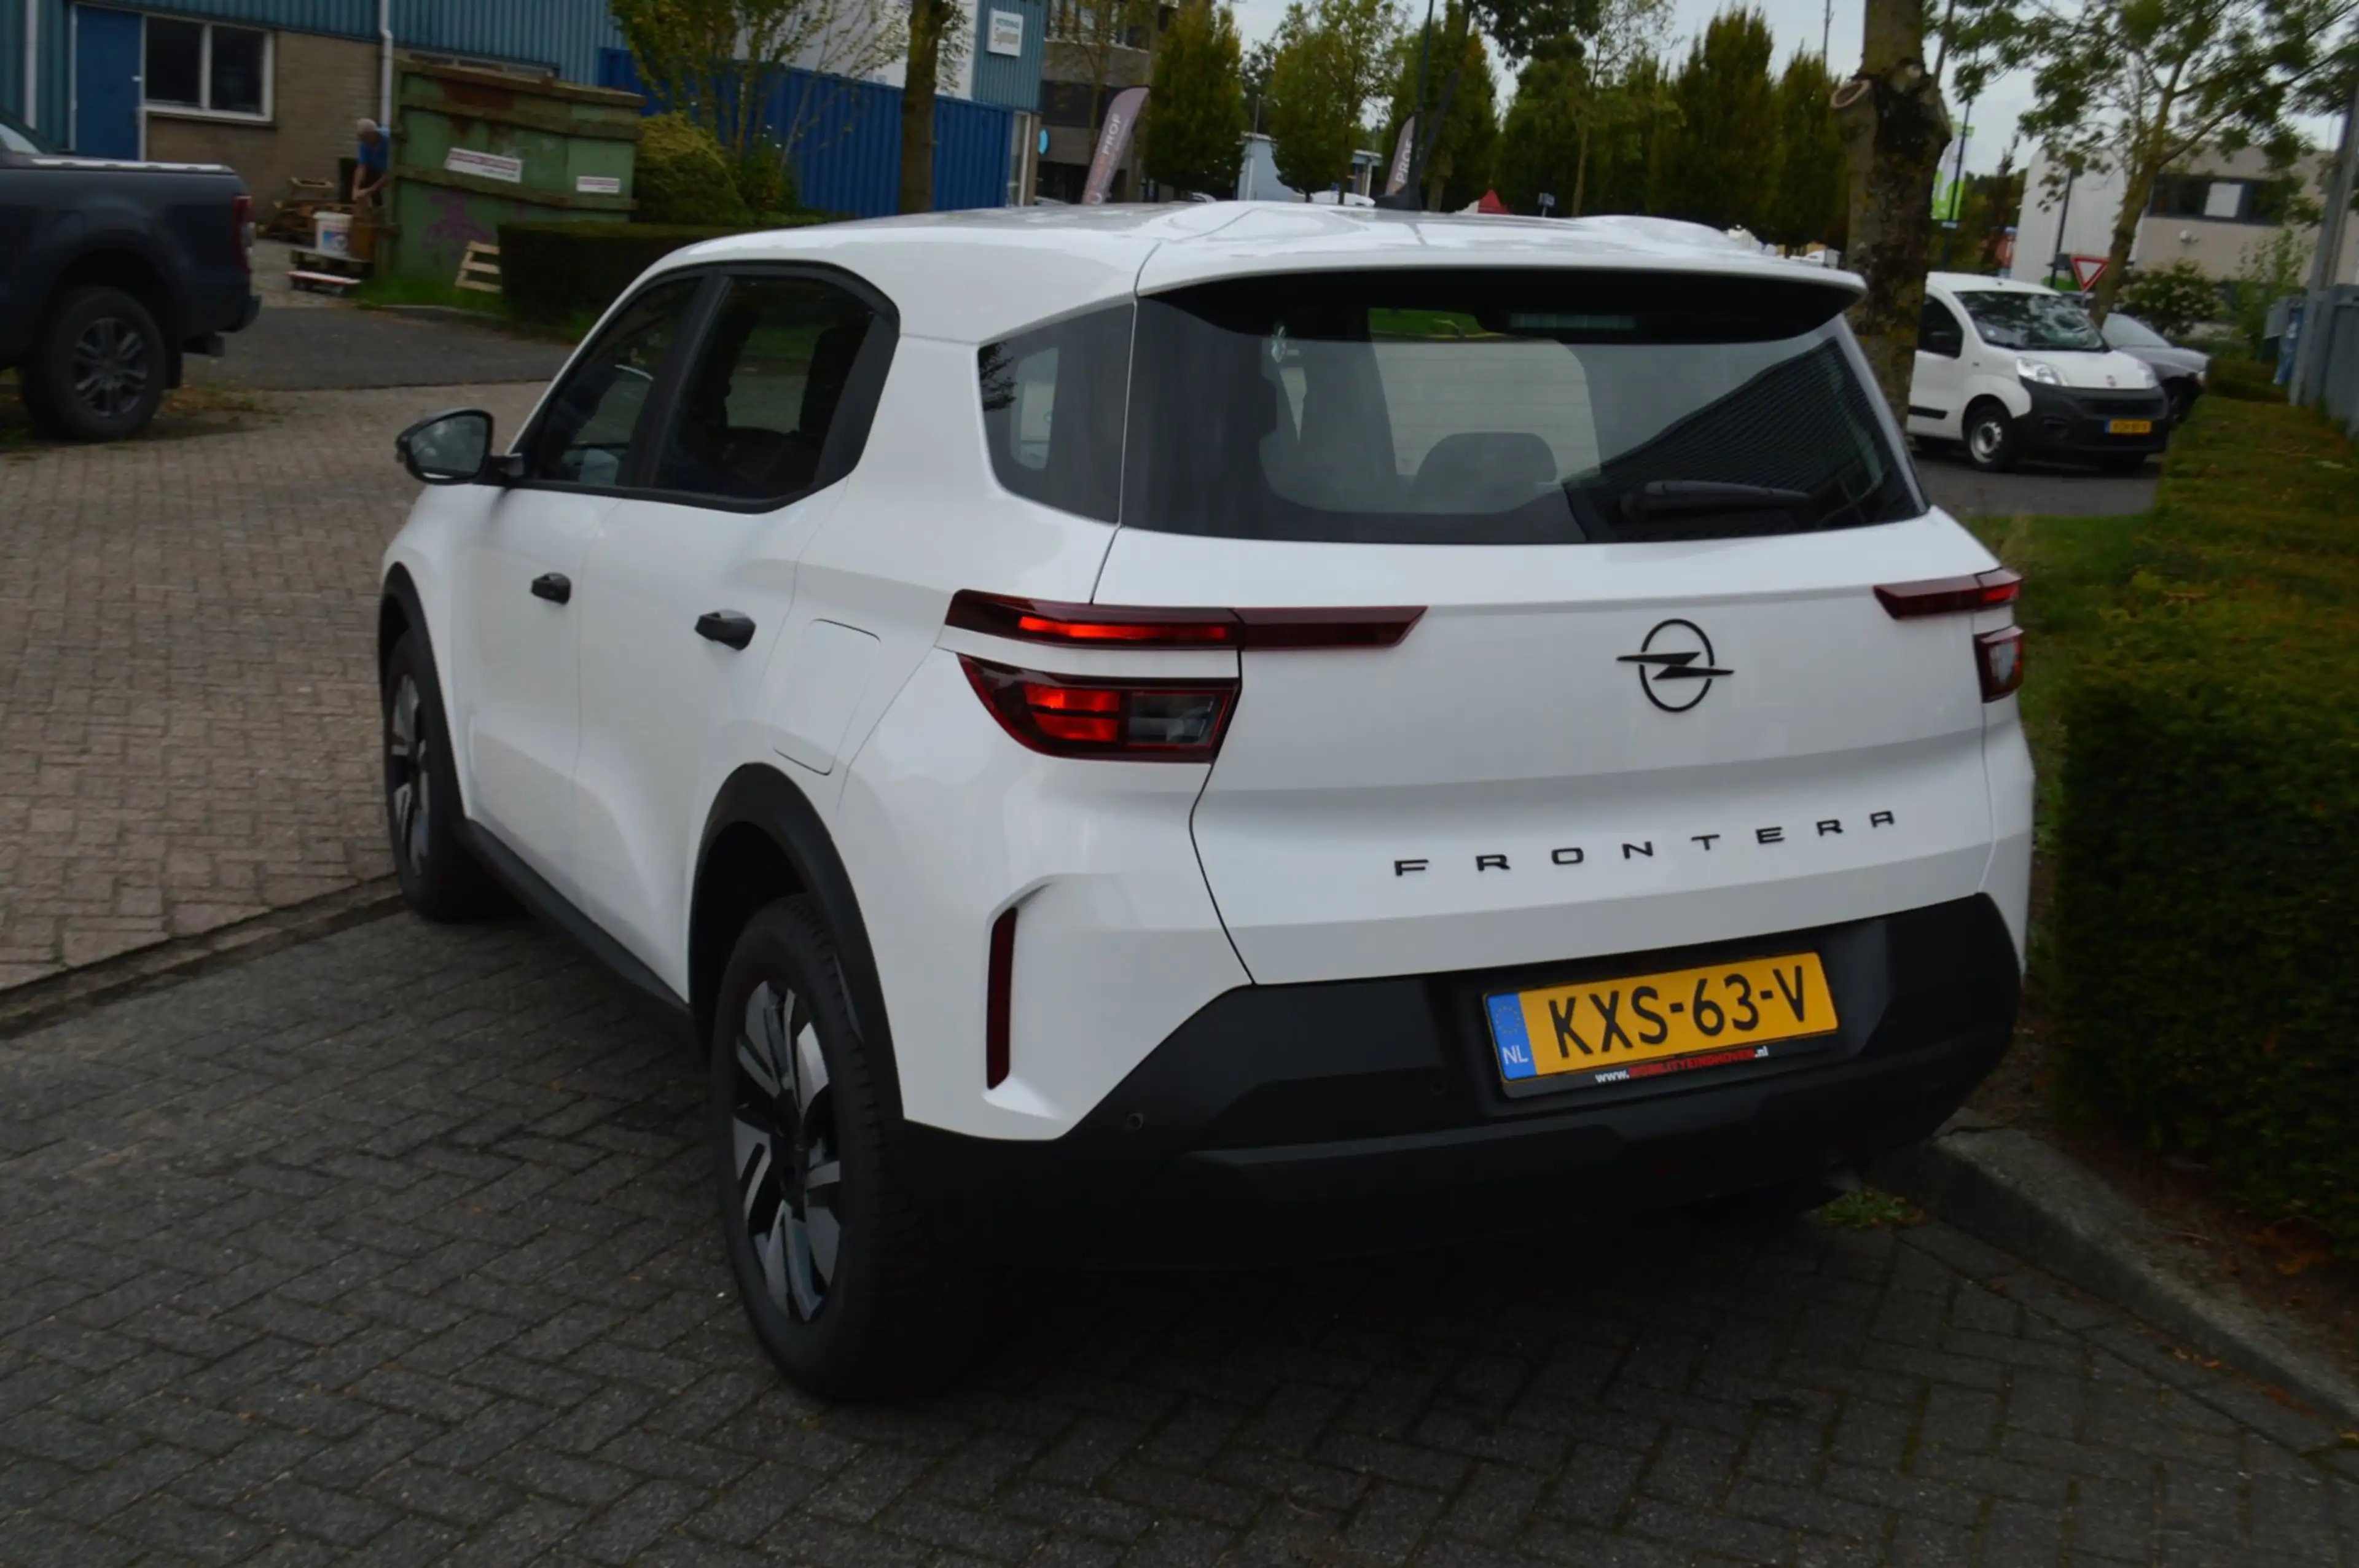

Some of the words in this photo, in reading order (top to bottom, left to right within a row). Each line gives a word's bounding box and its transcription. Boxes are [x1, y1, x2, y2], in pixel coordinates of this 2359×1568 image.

[1395, 811, 1894, 876] FRONTERA
[1549, 965, 1805, 1058] KXS-63-V
[1502, 1045, 1529, 1064] NL
